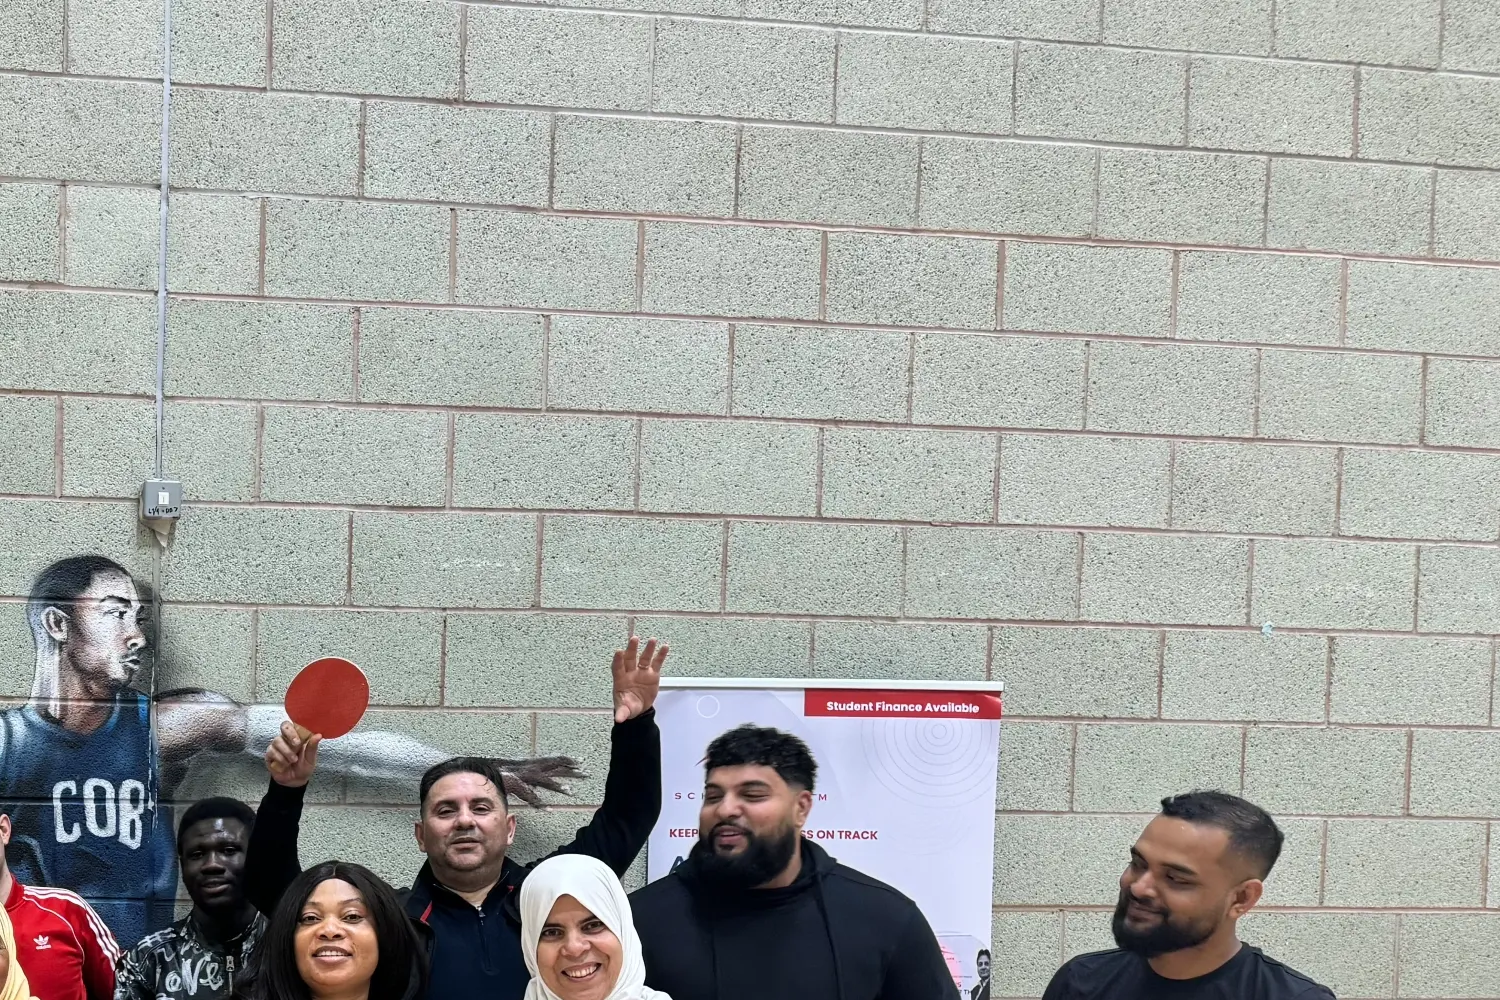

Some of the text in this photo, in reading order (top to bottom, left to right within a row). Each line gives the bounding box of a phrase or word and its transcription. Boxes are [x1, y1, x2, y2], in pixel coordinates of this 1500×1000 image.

[826, 701, 980, 714] Student Finance Available
[52, 777, 146, 851] COB
[669, 828, 698, 839] KEEP
[816, 830, 835, 840] ON
[837, 830, 879, 841] TRACK
